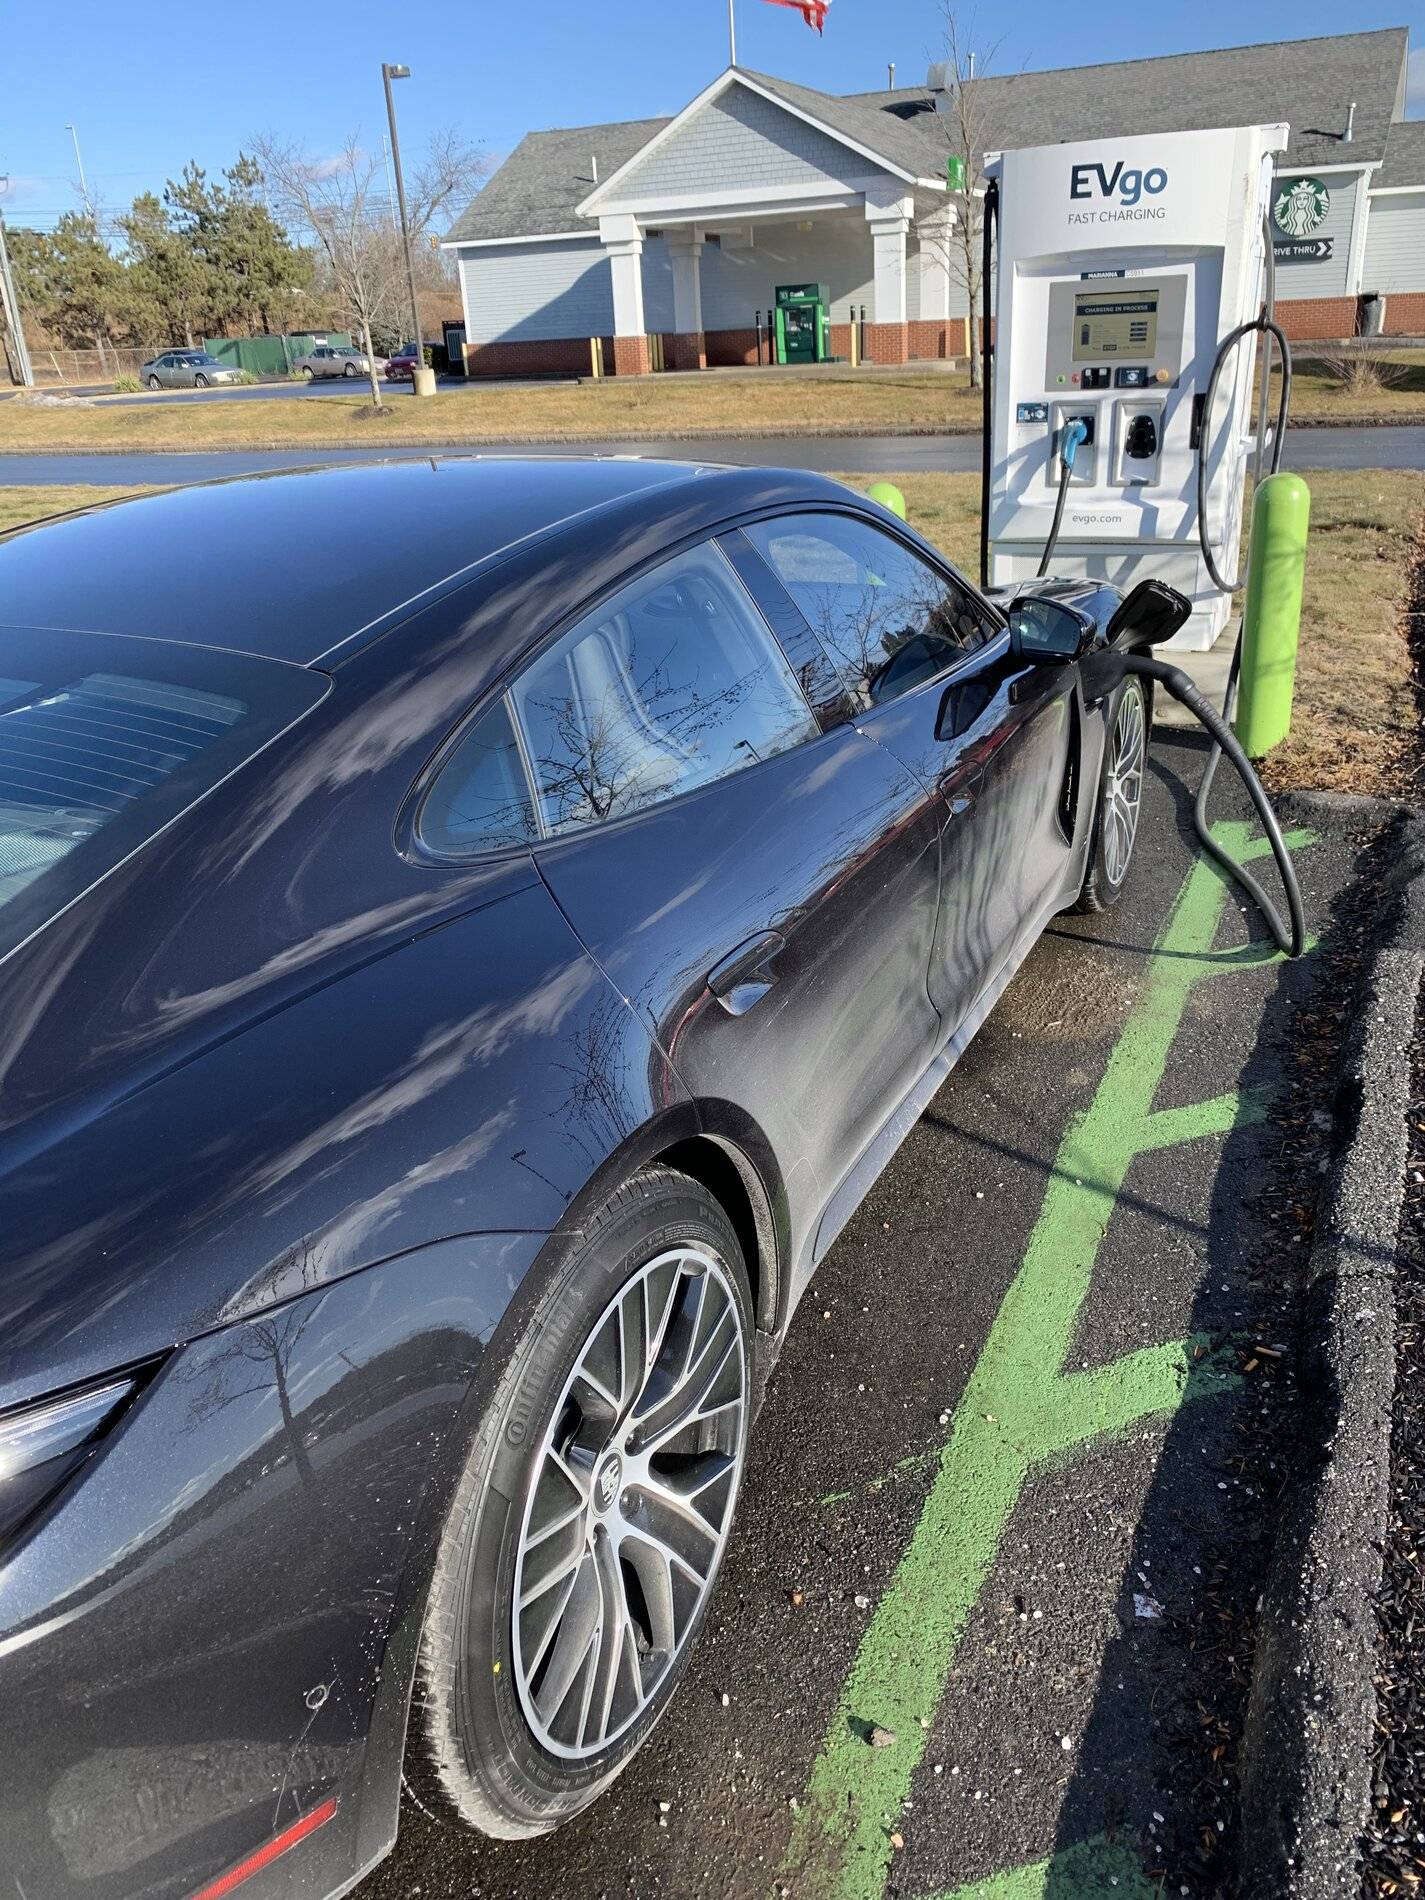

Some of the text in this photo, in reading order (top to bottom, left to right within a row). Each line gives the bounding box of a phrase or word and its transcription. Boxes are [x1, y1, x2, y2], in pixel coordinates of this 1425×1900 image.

[1070, 161, 1168, 205] EVgo
[1068, 207, 1166, 224] FAST CHARGING
[1273, 245, 1316, 256] RIVE THRU
[1088, 271, 1119, 279] MARIANNA
[1072, 515, 1122, 525] evgo.com
